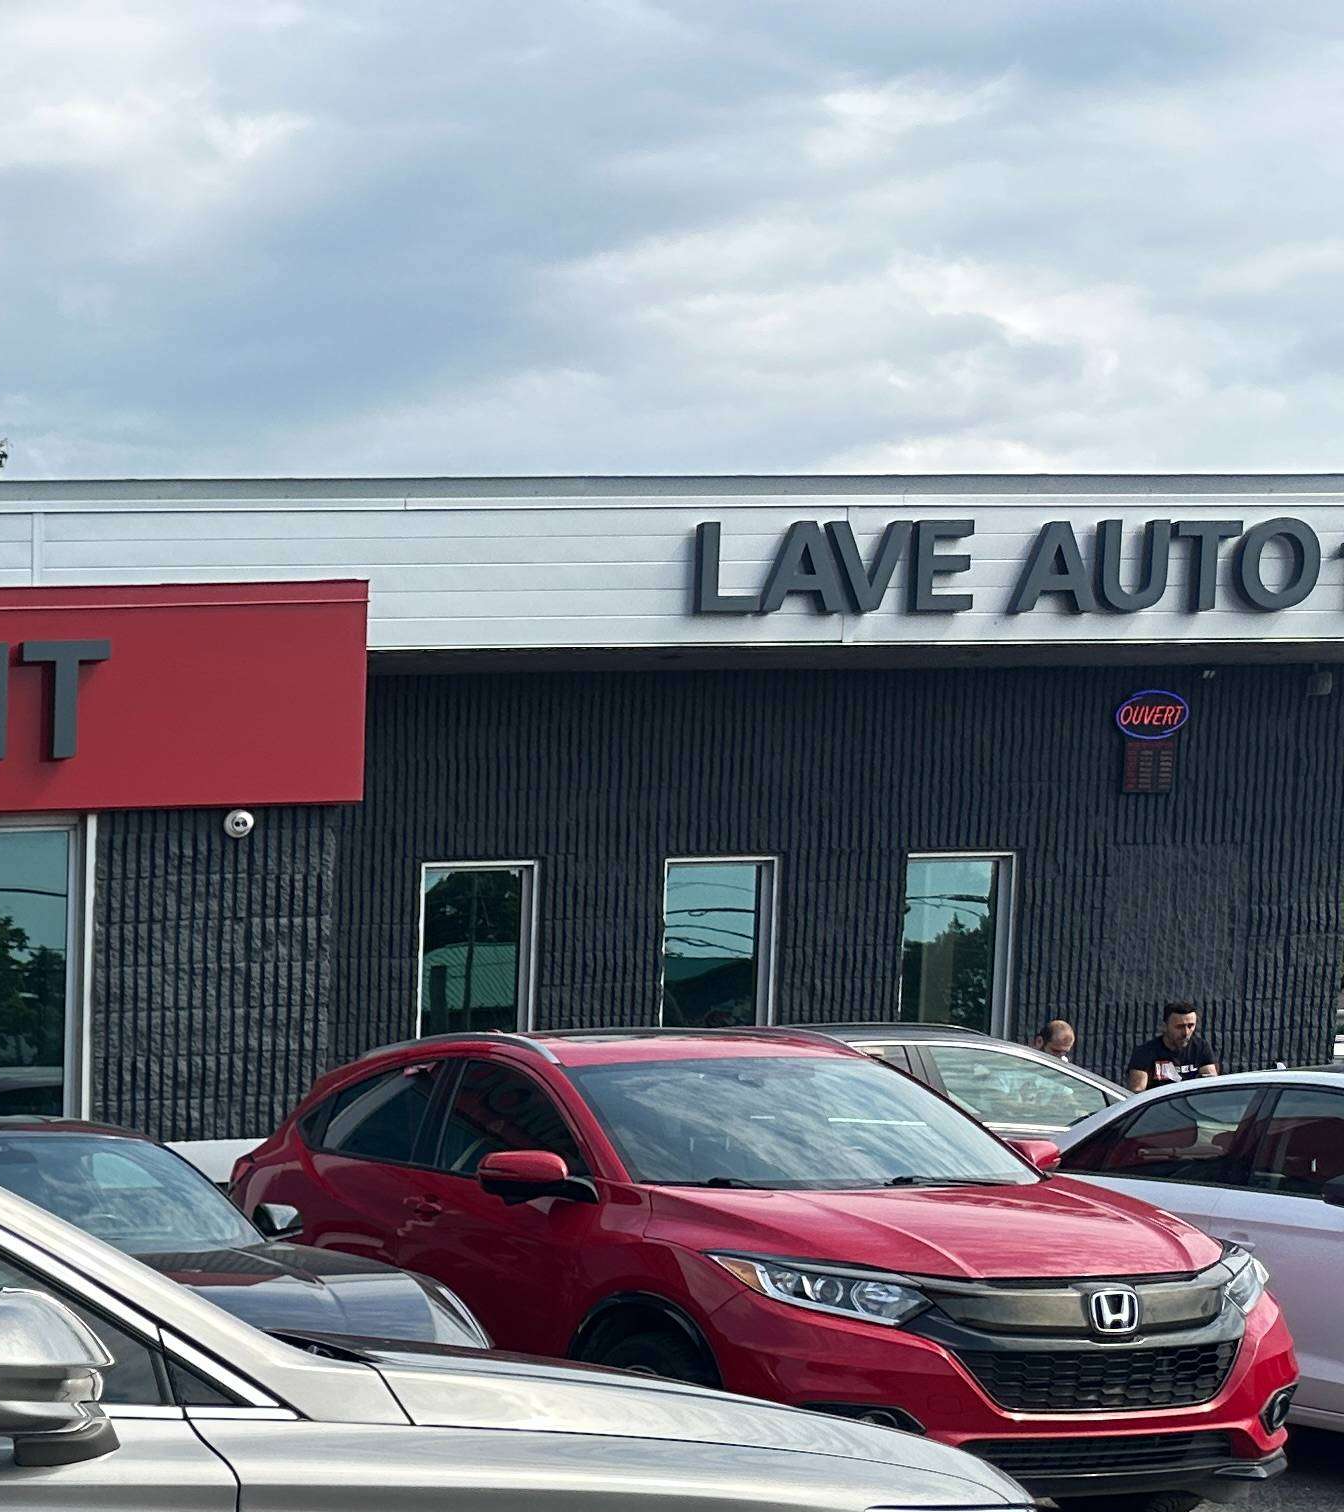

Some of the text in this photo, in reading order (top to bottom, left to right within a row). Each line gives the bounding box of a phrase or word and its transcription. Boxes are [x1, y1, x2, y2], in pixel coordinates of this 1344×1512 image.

[694, 516, 1321, 615] LAVE AUTO
[1119, 705, 1185, 726] OUVERT
